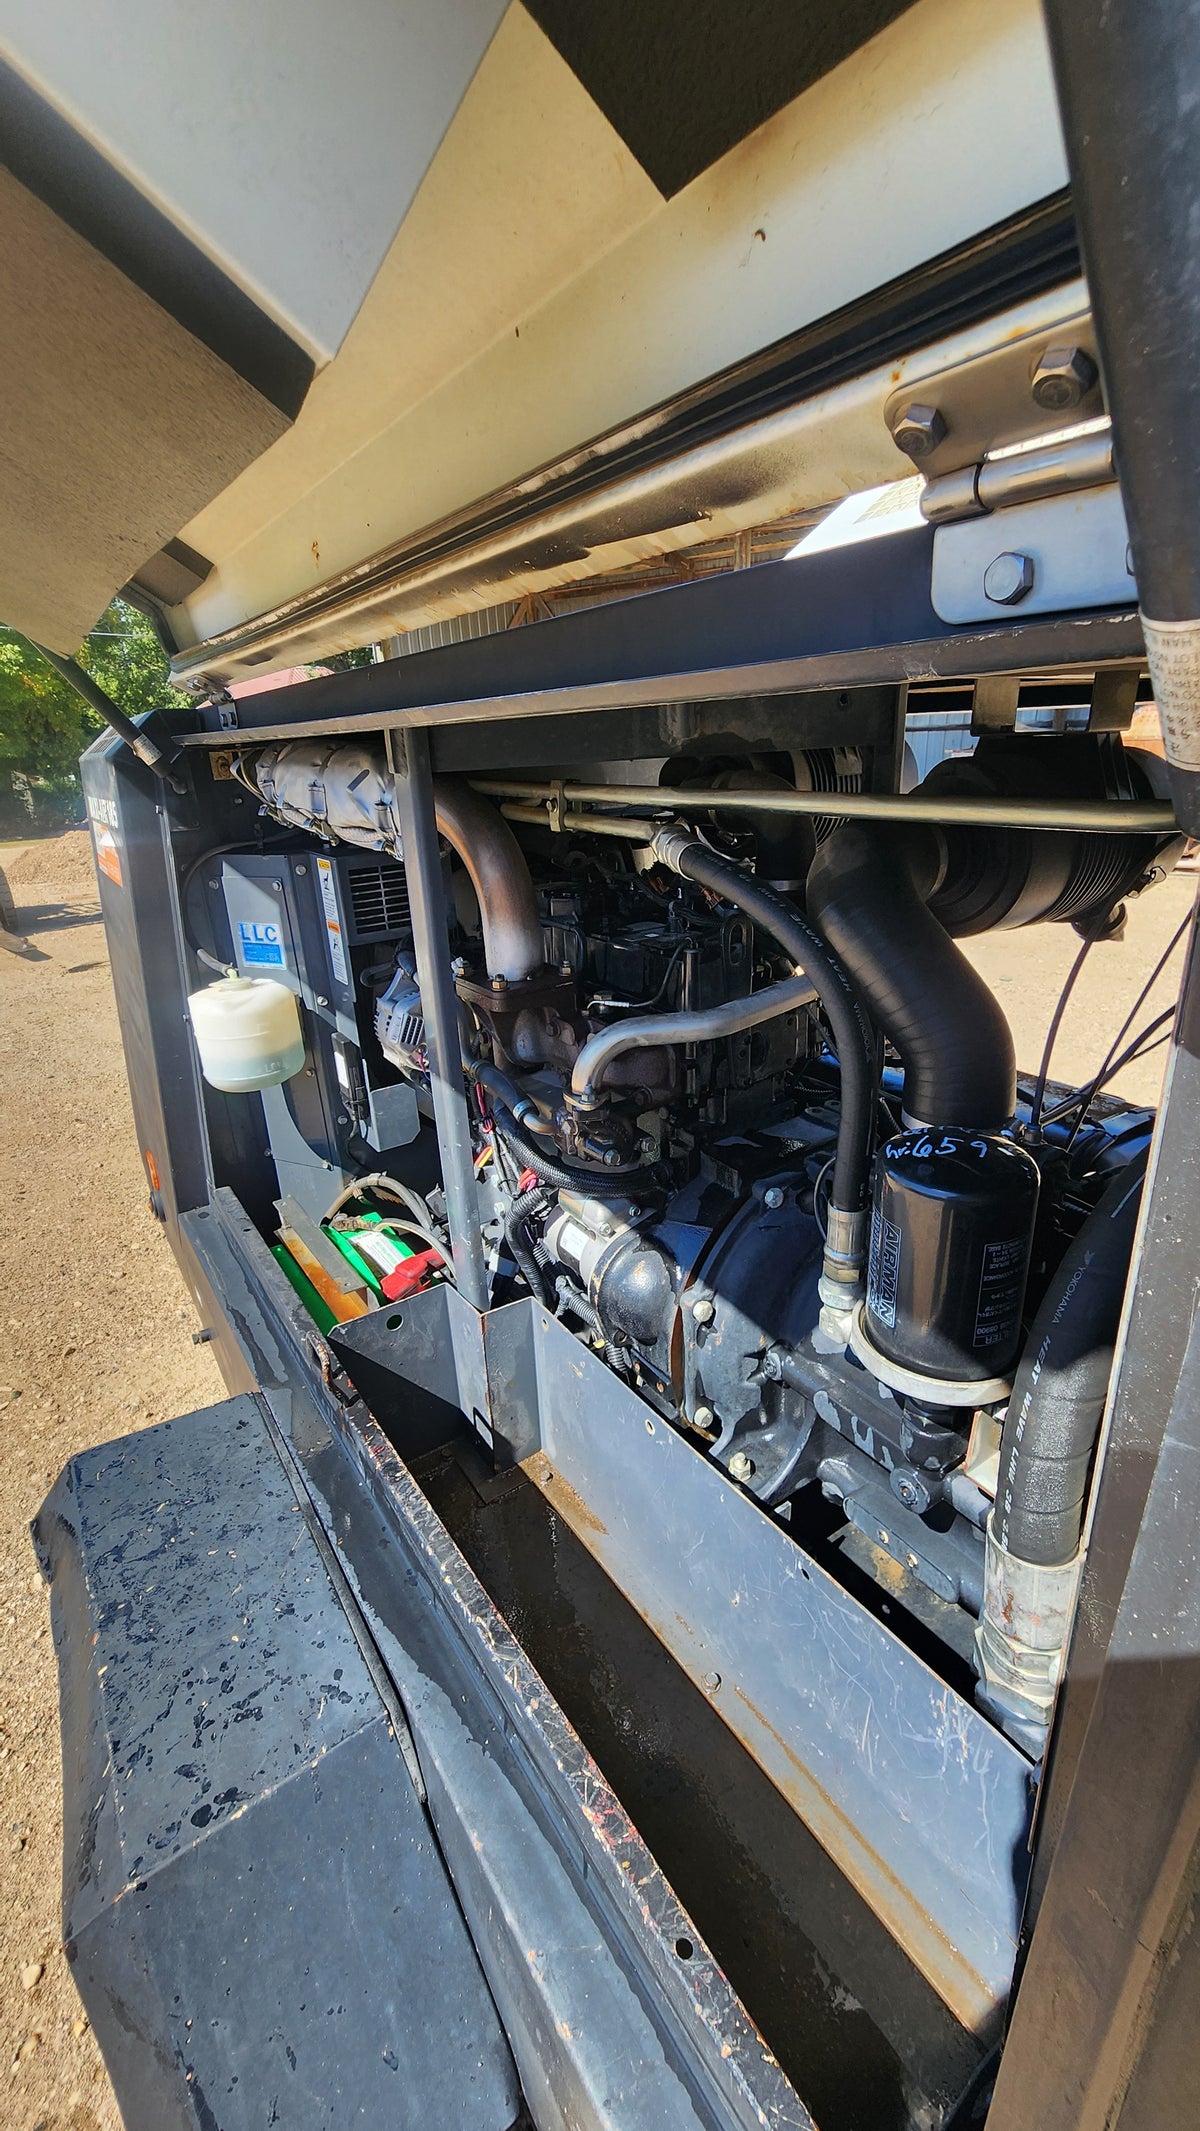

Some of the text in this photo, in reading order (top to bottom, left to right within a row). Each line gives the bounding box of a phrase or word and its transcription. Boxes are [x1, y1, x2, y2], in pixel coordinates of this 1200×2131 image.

[240, 923, 277, 942] LLC
[788, 914, 825, 948] WAVE
[826, 956, 853, 993] HEAT
[878, 1221, 900, 1325] AIRMAN
[1051, 1266, 1088, 1325] YOKOHAMA
[1031, 1334, 1052, 1386] HEAT
[1015, 1390, 1033, 1443] WAVE
[1006, 1445, 1020, 1486] LHW
